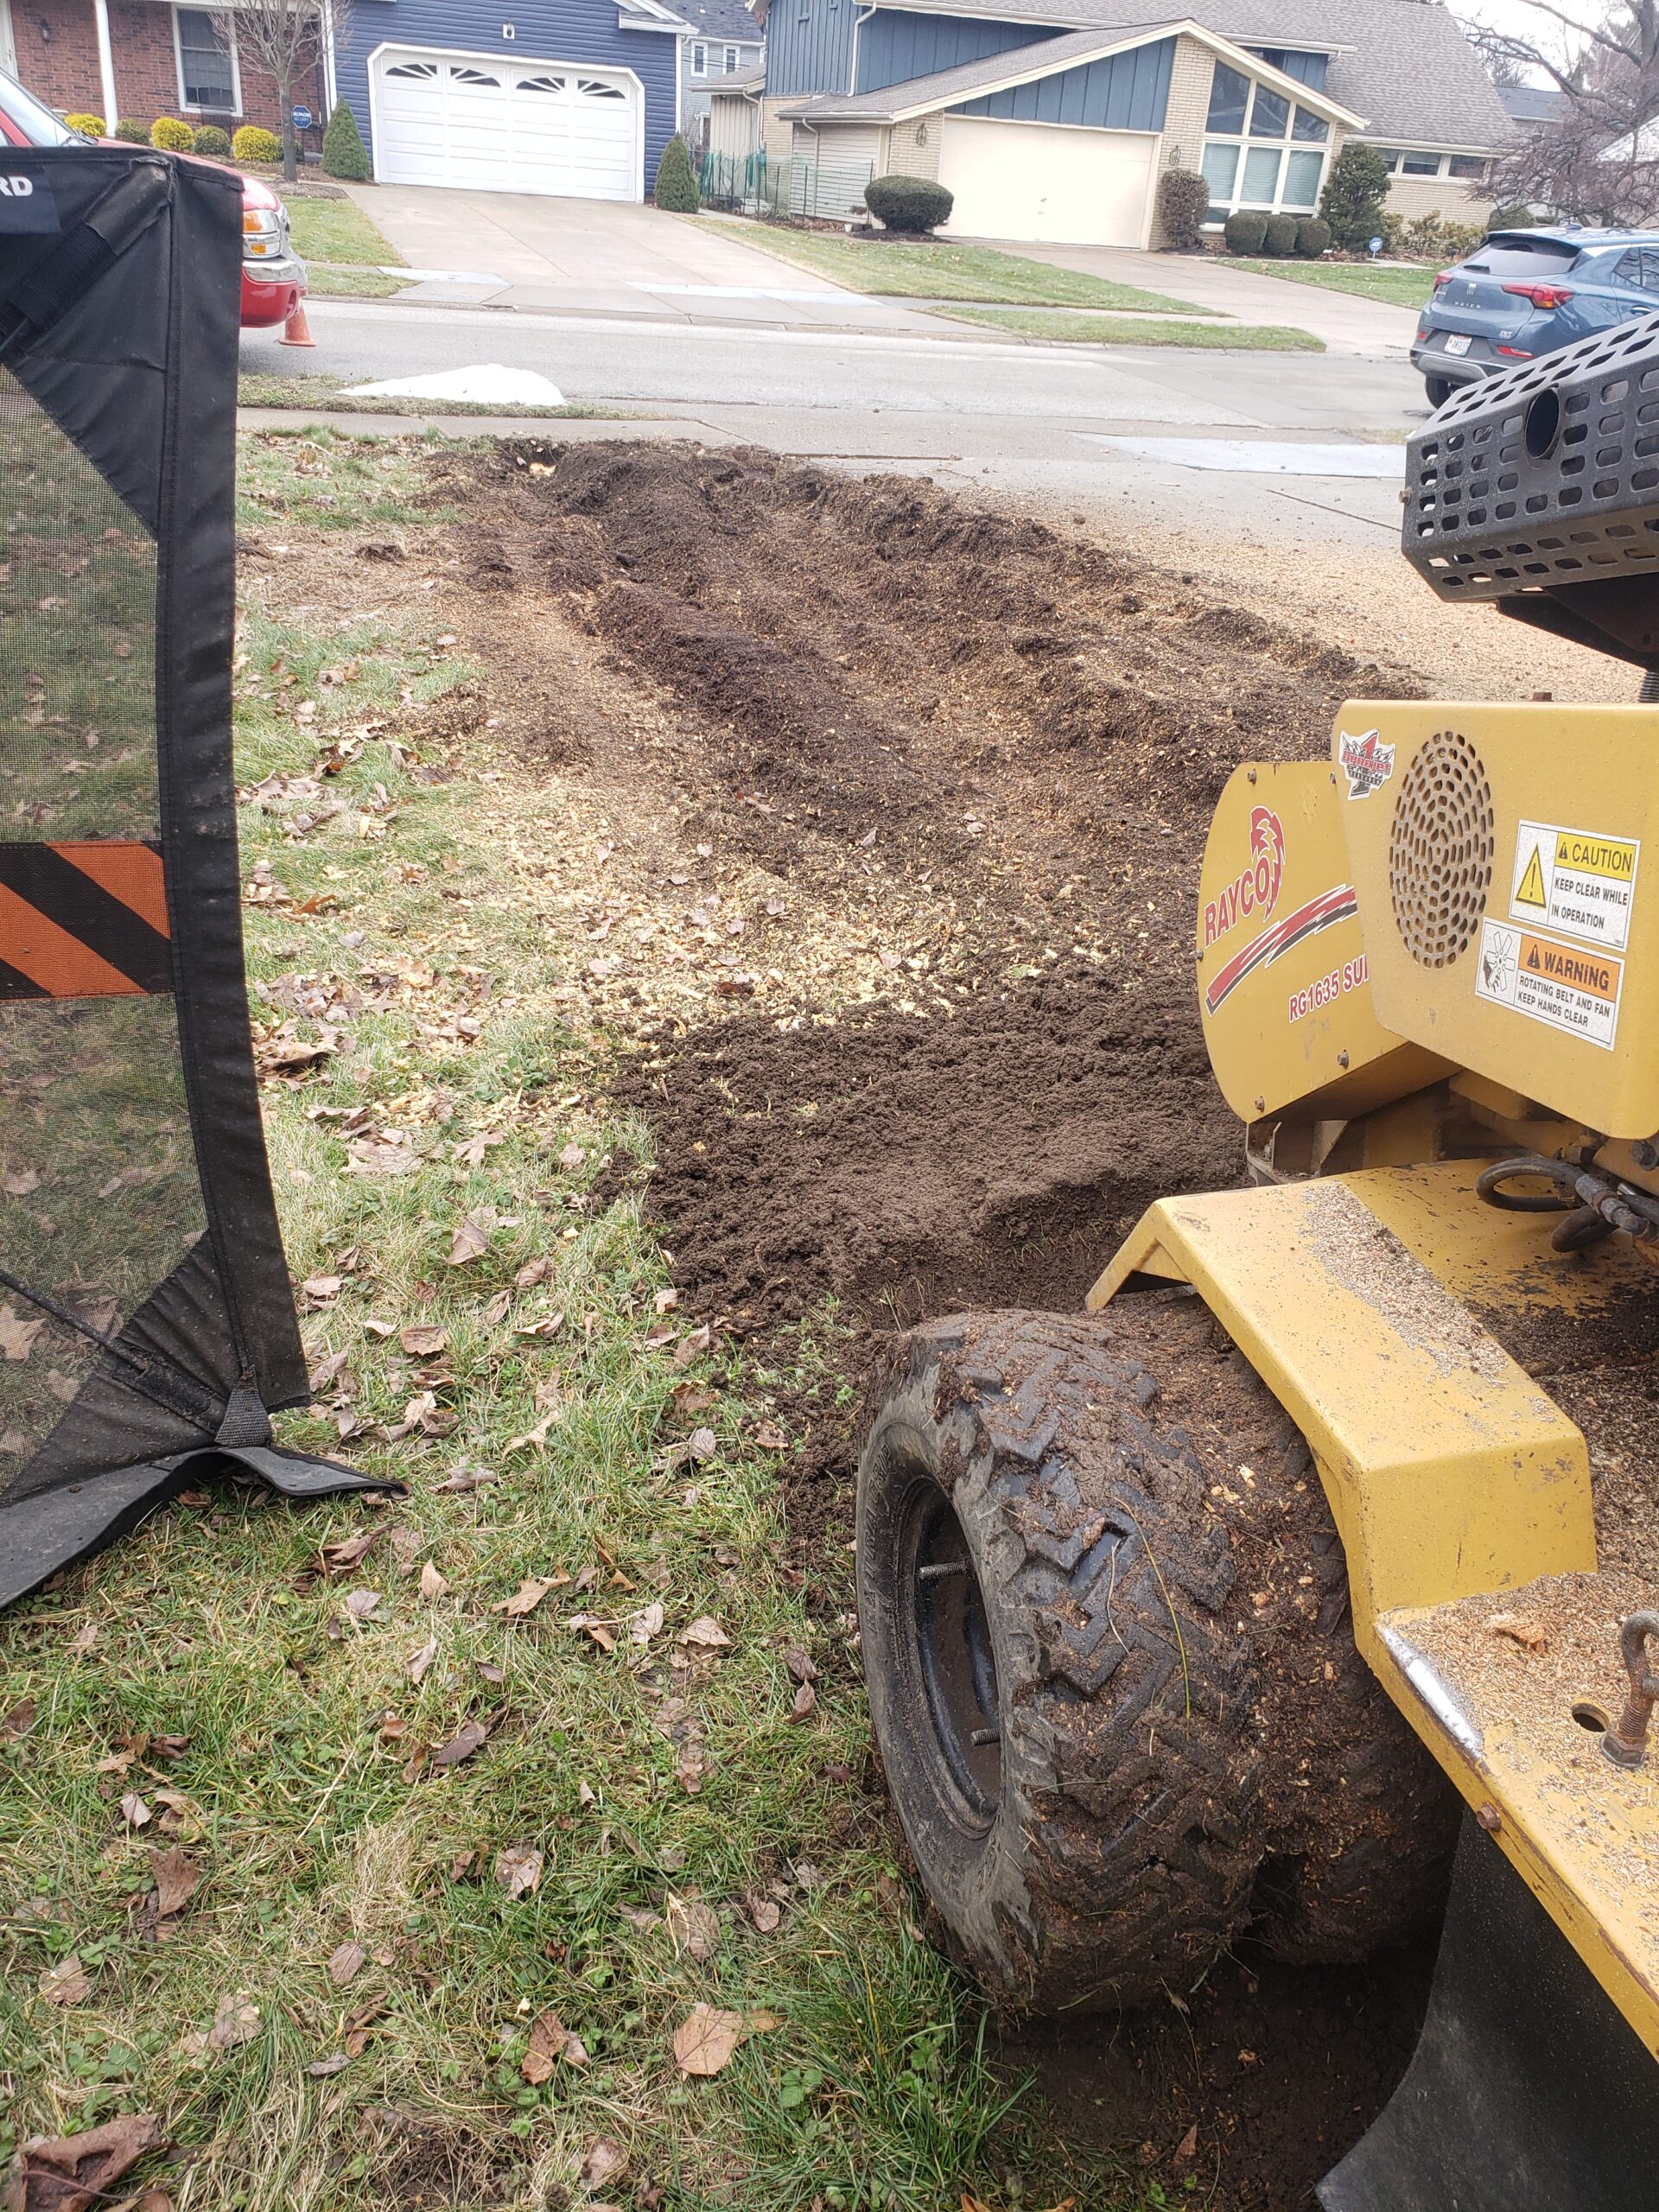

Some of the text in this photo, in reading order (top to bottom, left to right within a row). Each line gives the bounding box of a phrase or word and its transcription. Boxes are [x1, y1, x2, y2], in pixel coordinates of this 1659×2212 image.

[1341, 748, 1391, 775] Dynajet
[1572, 843, 1632, 873] CAUTION
[1205, 855, 1270, 948] RAYCO
[1554, 877, 1628, 906] KEEP CLEAR WHILE
[1551, 904, 1605, 929] IN OPERATION
[1544, 951, 1609, 991] WARNING
[1289, 969, 1339, 1023] RG1635
[1518, 991, 1588, 1027] KEEP HANDS CLEAR
[1519, 976, 1610, 1018] ROTATING BELT AND FAN
[868, 1444, 891, 1503] GRIP
